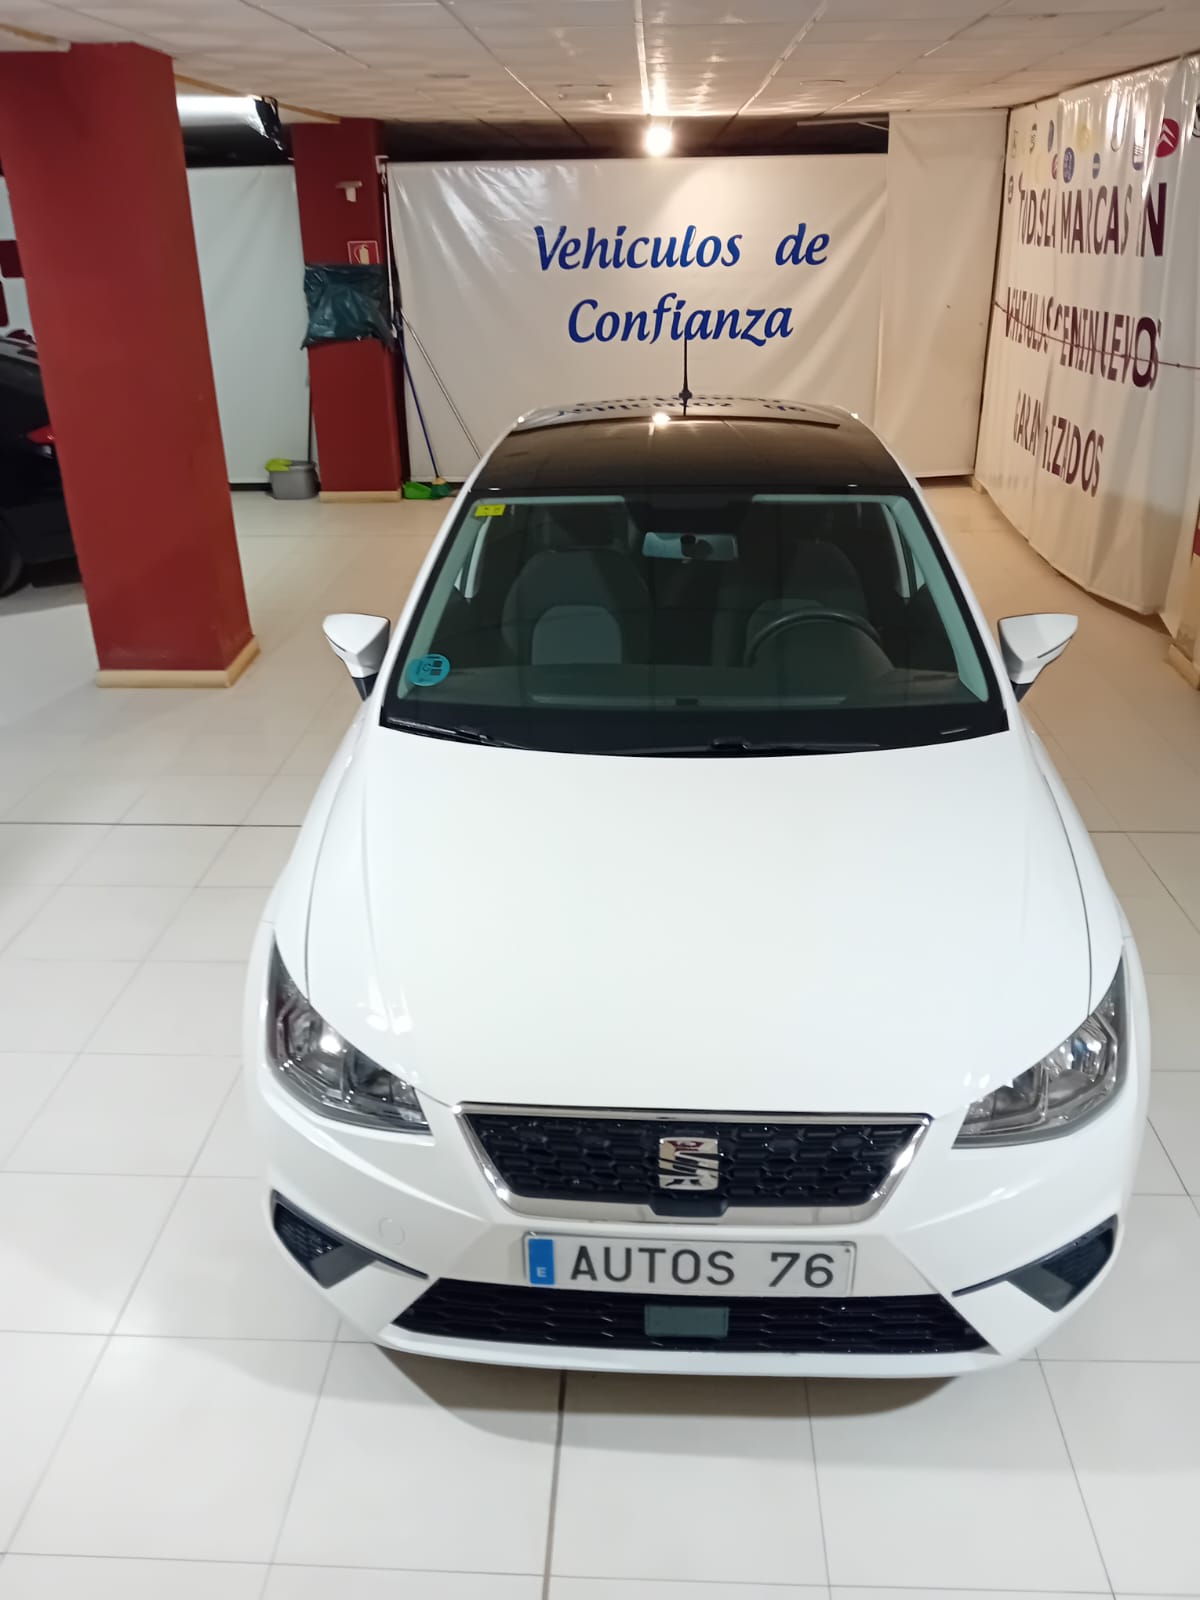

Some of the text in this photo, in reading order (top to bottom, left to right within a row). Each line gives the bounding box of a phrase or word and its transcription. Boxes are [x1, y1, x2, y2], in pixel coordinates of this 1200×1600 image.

[775, 223, 830, 266] de
[1060, 184, 1132, 256] MARCAS
[568, 292, 794, 347] Confianza
[536, 1245, 835, 1289] E AUTOS 76
